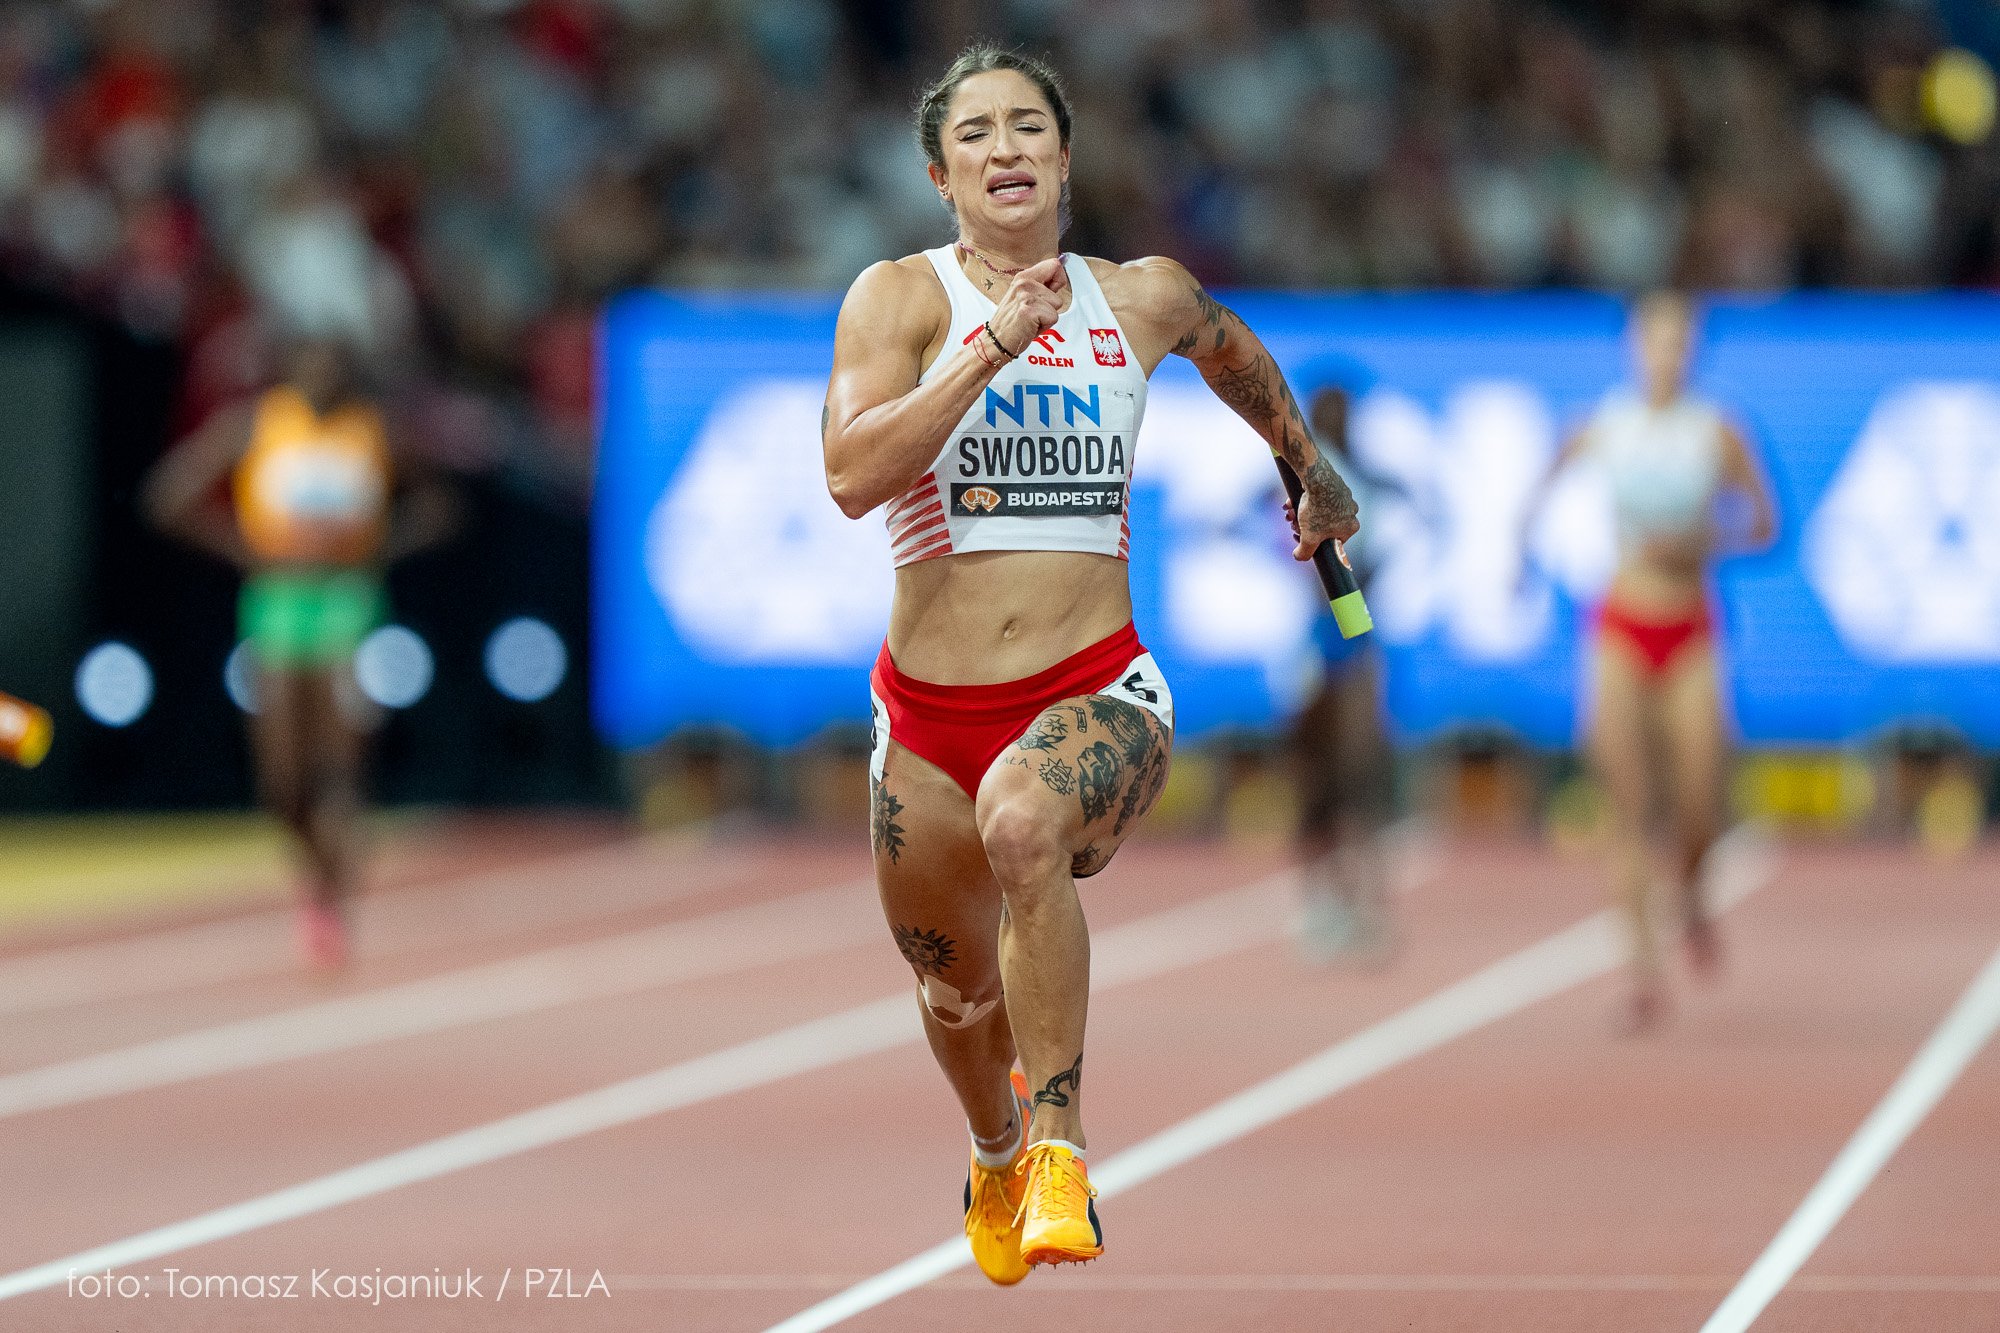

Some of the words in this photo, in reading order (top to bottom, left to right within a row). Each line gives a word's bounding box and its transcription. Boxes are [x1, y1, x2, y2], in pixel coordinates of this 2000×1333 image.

[1027, 355, 1074, 368] ORLEN
[986, 385, 1100, 429] NTN
[958, 435, 1125, 477] SWOBODA
[1007, 492, 1104, 507] BUDAPEST
